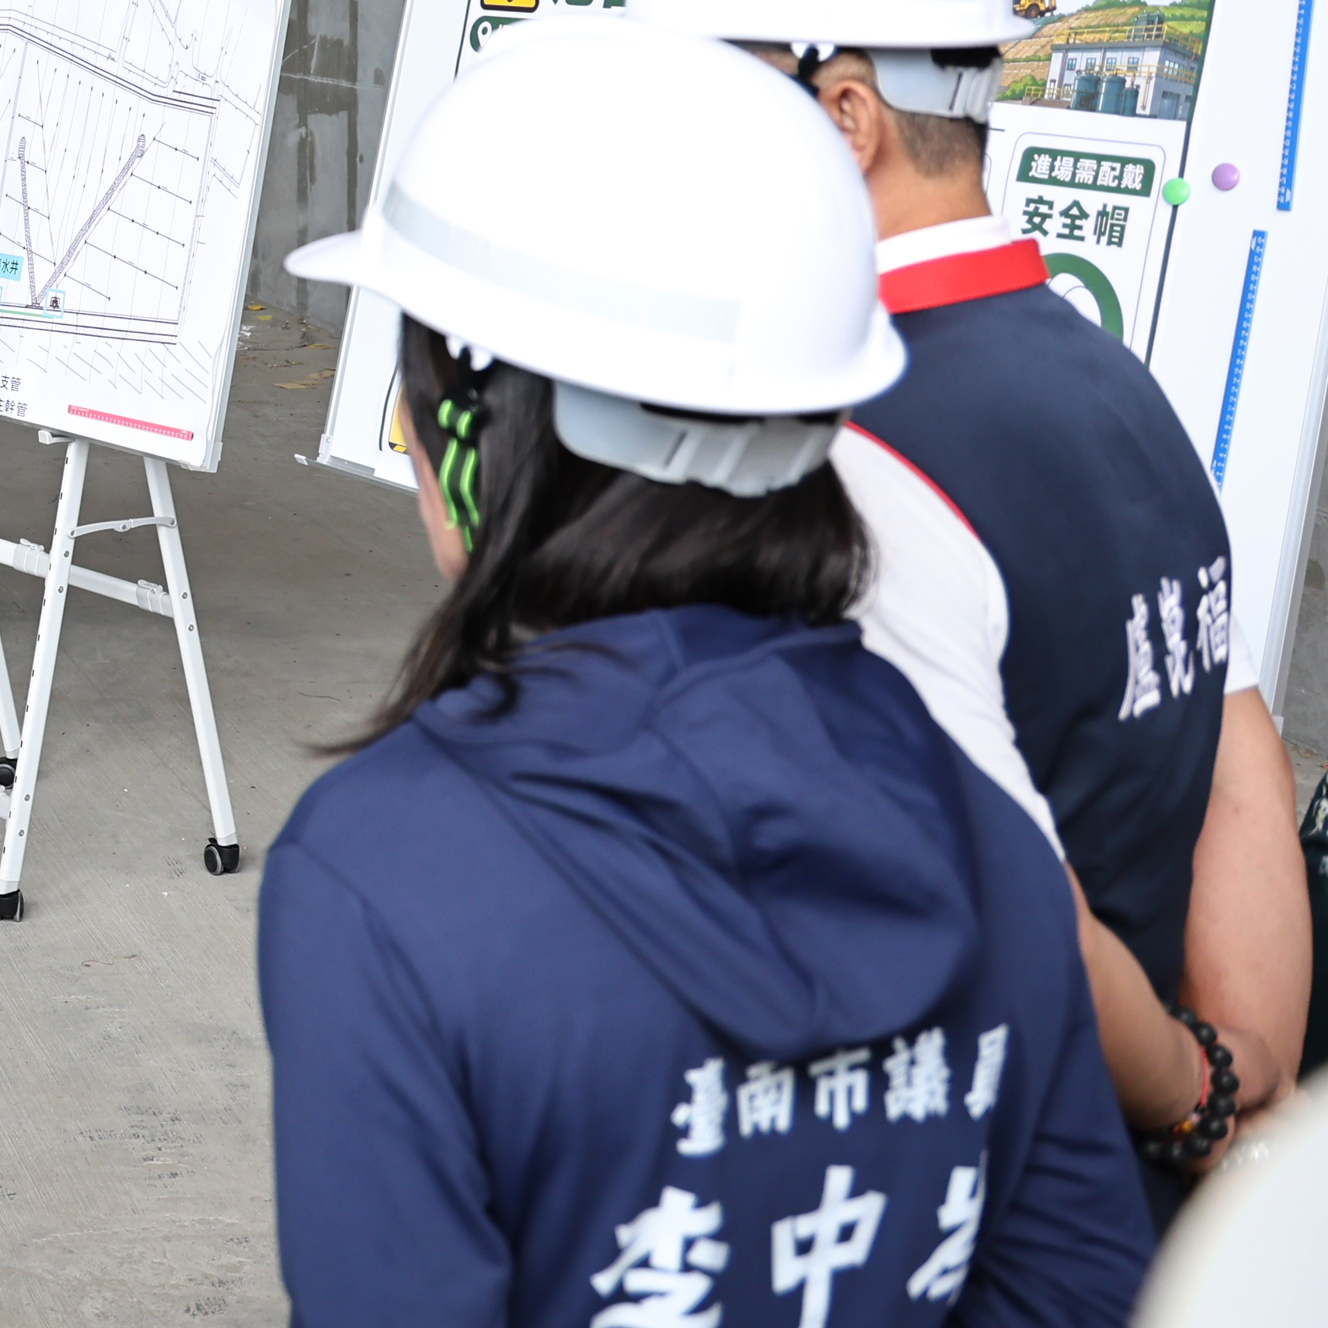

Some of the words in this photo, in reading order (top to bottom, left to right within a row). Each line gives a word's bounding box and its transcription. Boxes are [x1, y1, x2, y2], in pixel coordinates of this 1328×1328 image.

[1028, 154, 1144, 191] 進場需配戴
[1021, 195, 1130, 249] 安全帽
[0, 375, 22, 392] 支管
